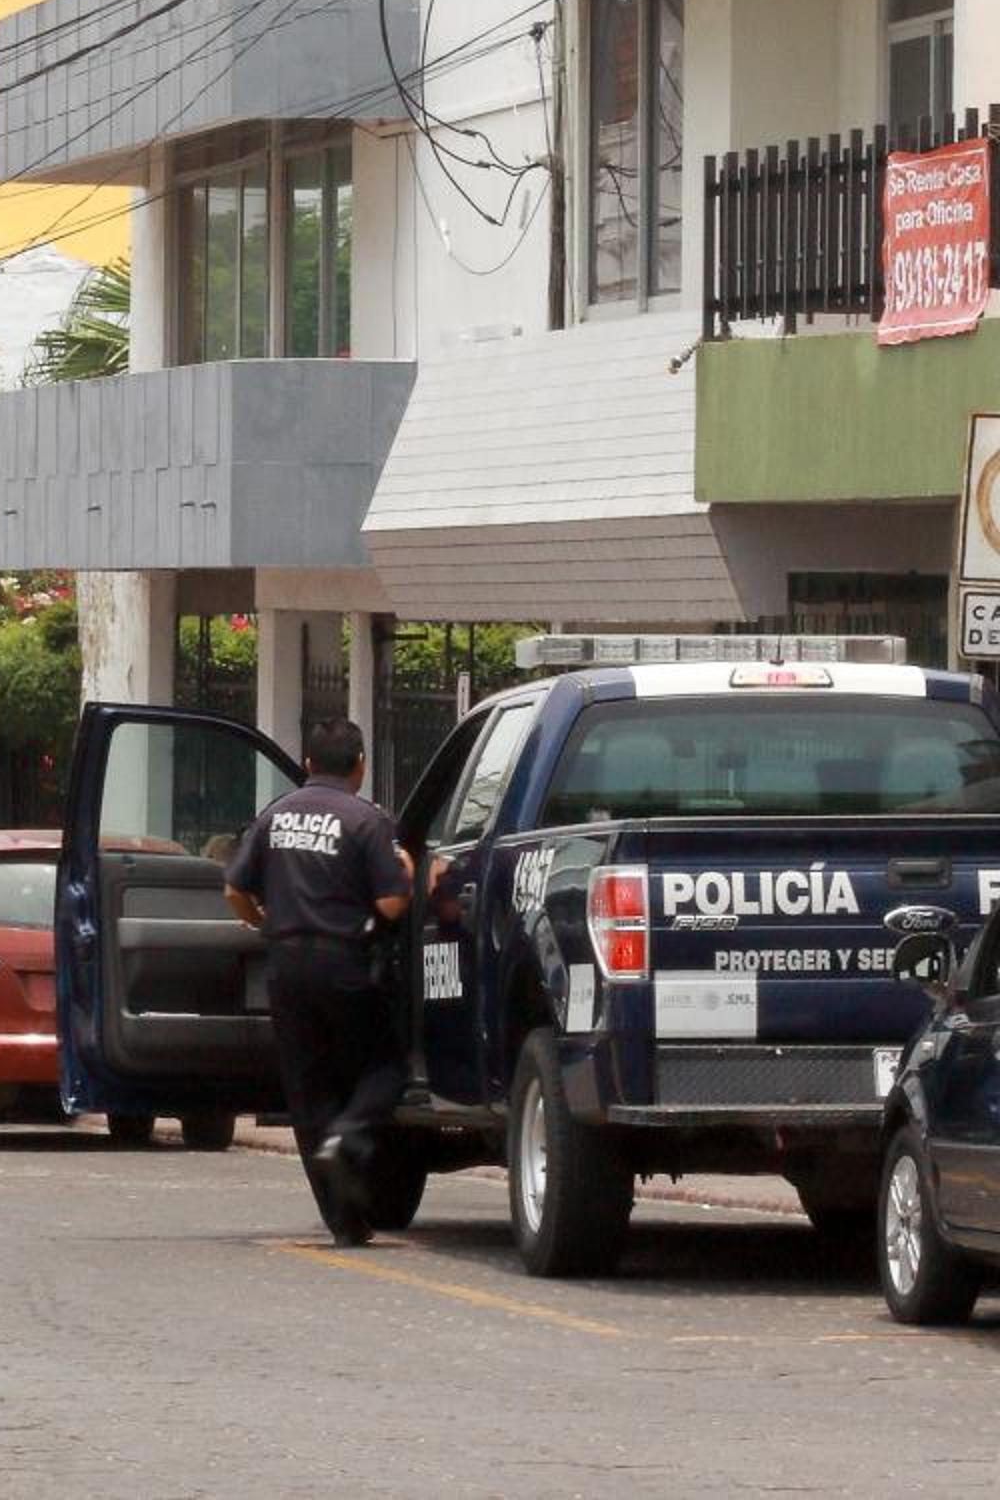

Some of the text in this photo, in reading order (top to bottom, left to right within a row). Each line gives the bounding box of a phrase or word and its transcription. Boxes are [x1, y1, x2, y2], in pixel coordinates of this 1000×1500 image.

[888, 163, 981, 197] Se Renta Casa
[895, 199, 974, 238] para Oficina
[271, 812, 341, 838] POLICÍA
[269, 831, 339, 855] FEDERAL
[663, 862, 860, 915] POLICÍA
[715, 950, 831, 972] PROTEGER
[836, 950, 851, 970] Y
